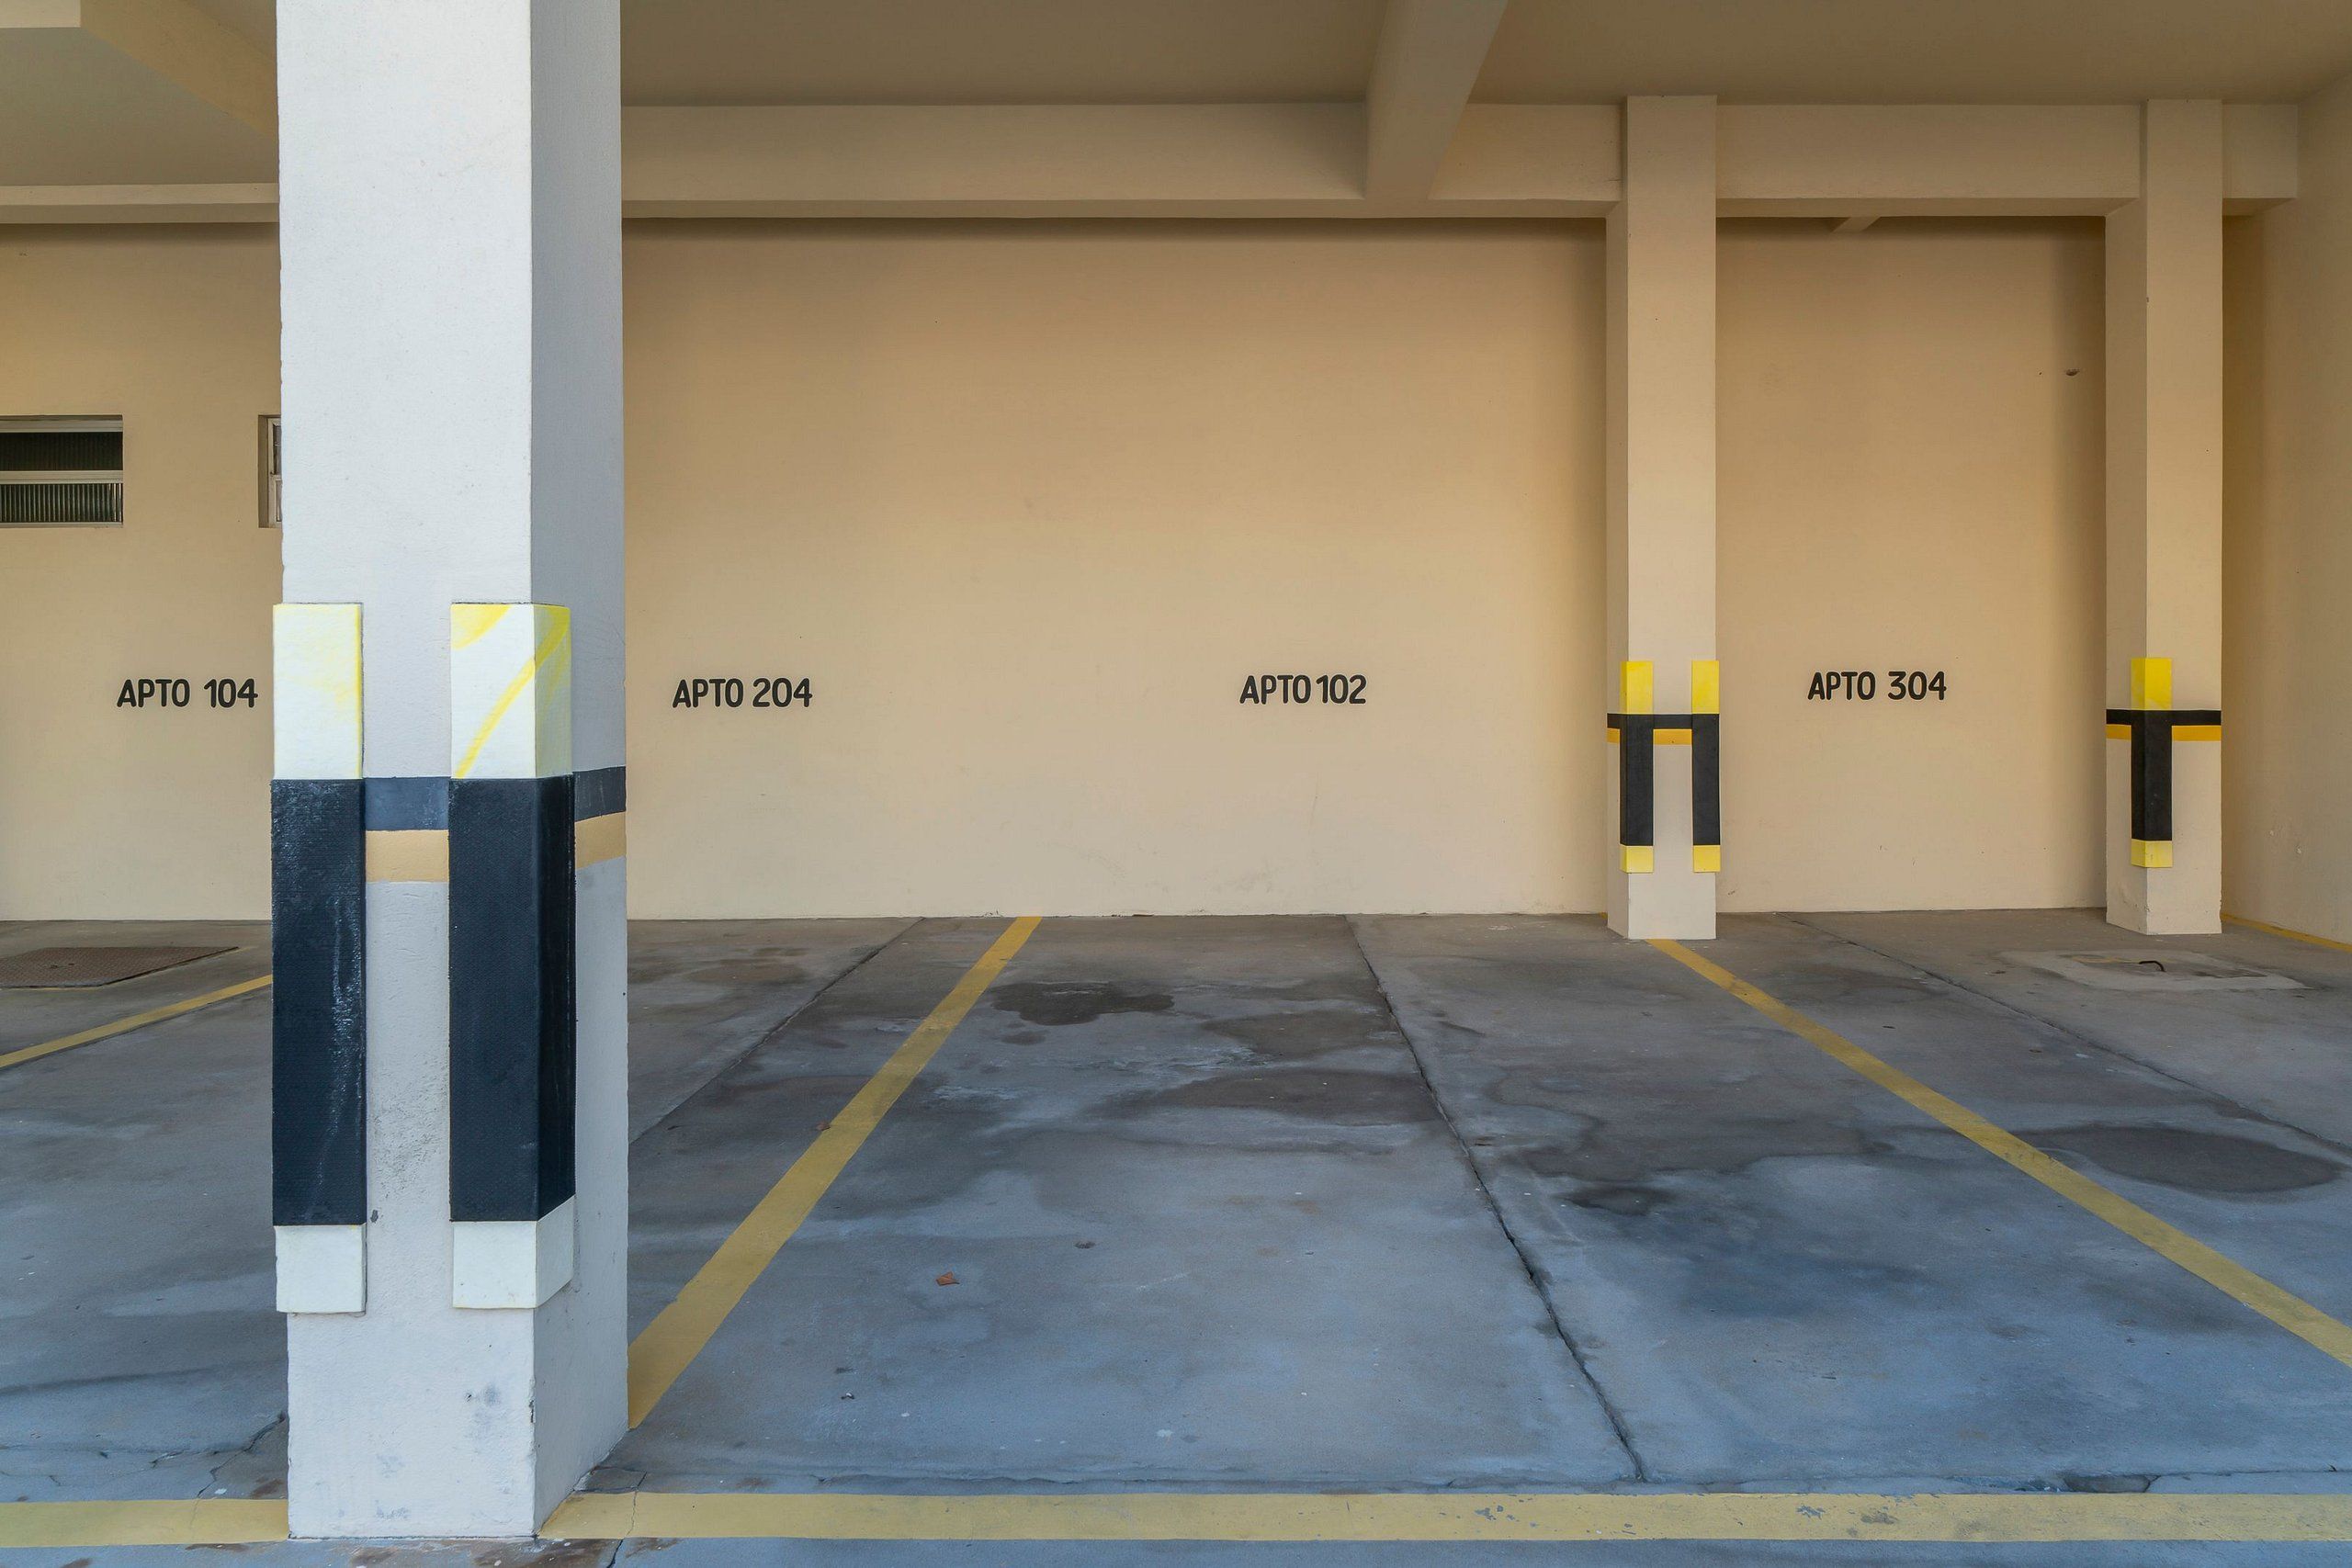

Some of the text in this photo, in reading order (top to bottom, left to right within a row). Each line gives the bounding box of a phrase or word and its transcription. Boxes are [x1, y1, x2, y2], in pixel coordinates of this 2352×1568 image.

[116, 678, 259, 708] APTO 104
[672, 677, 813, 708] APTO 204
[1239, 673, 1367, 705] APTO 102
[1807, 671, 1948, 701] APTO 304
